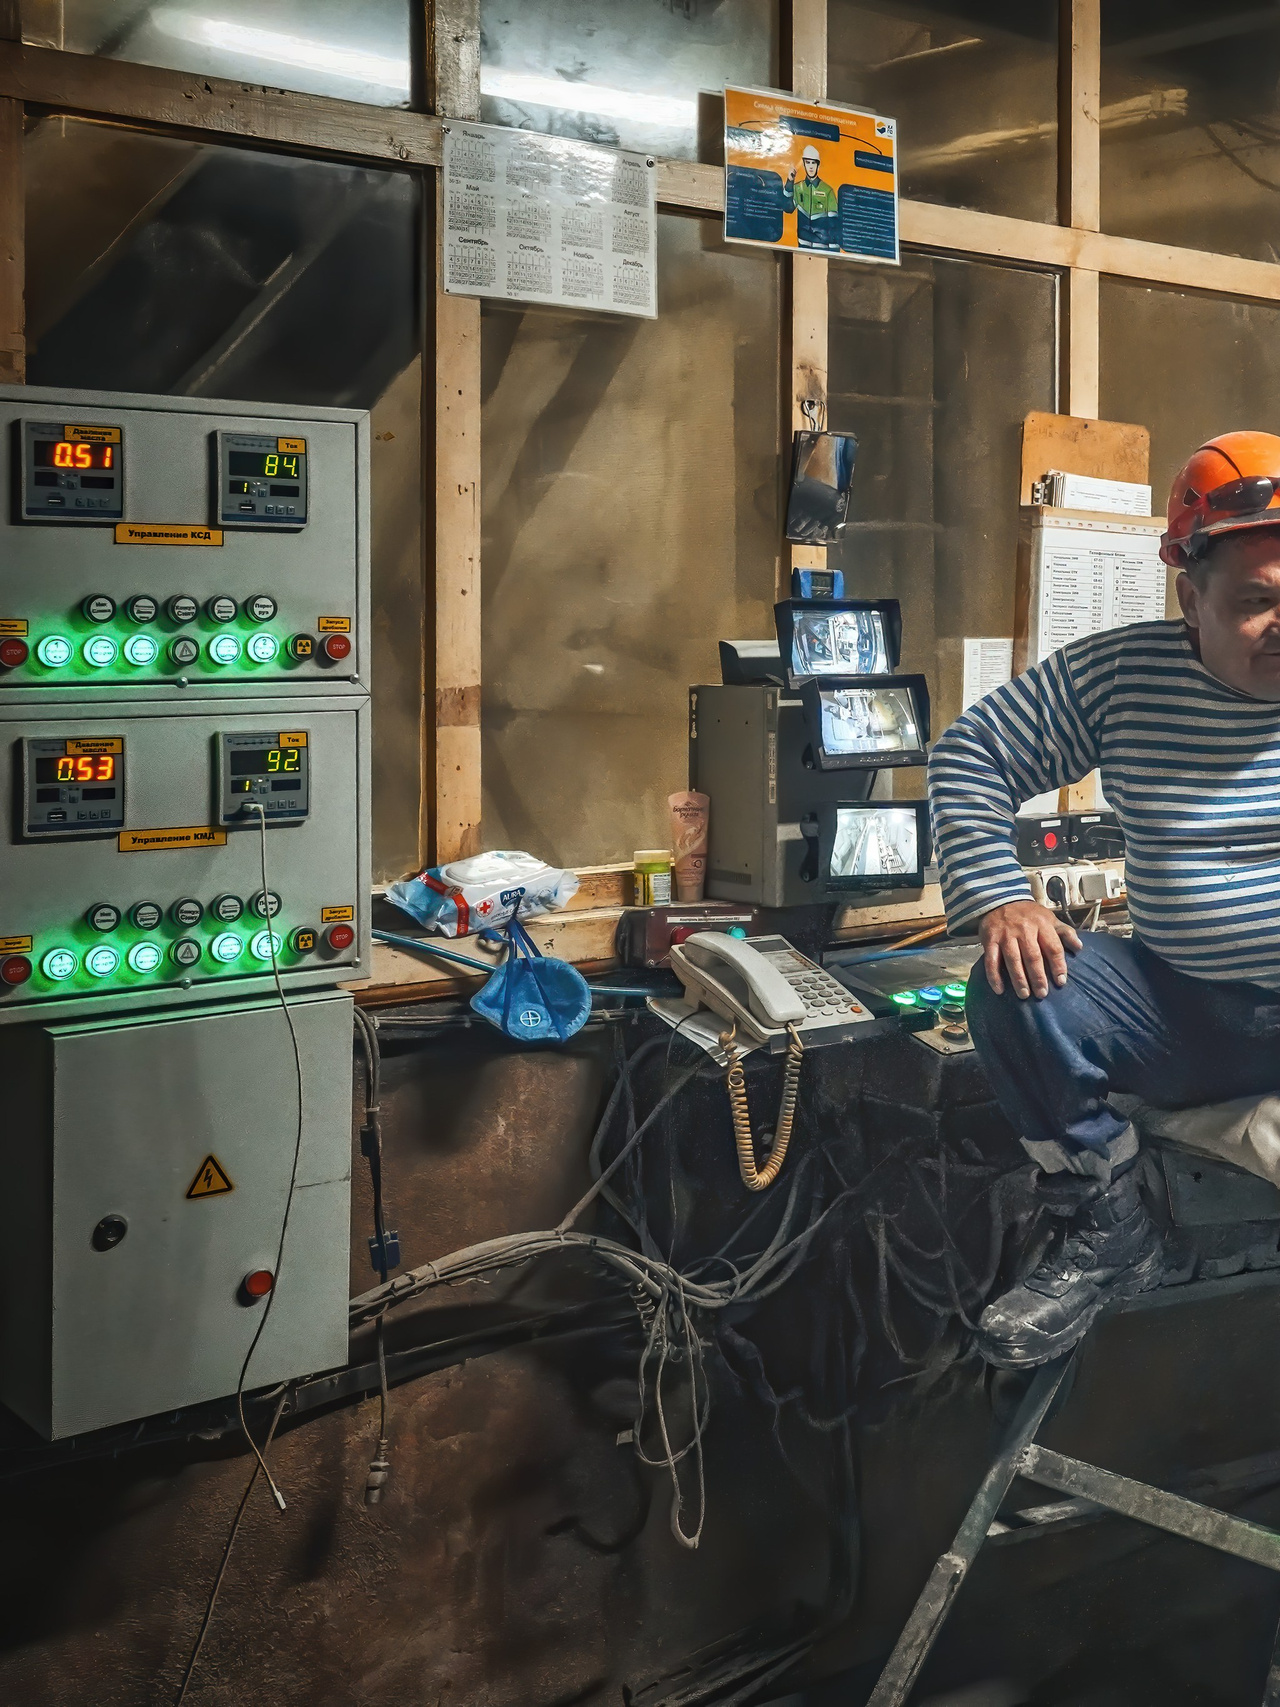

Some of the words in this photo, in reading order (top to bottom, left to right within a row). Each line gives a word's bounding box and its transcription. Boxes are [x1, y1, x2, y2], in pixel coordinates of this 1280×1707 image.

[463, 130, 486, 139] Январь
[458, 236, 489, 246] Сентябрь
[518, 243, 544, 253] Октябрь
[573, 251, 594, 260] Ноябрь
[623, 258, 643, 268] Декабрь
[243, 482, 248, 493] 1
[128, 529, 189, 539] Управление
[190, 531, 212, 540] КСД
[57, 756, 114, 781] 0.53
[245, 780, 250, 791] 1
[131, 835, 191, 845] Управление
[193, 832, 215, 841] КМД
[502, 889, 521, 902] AURA
[9, 966, 25, 974] STOP
